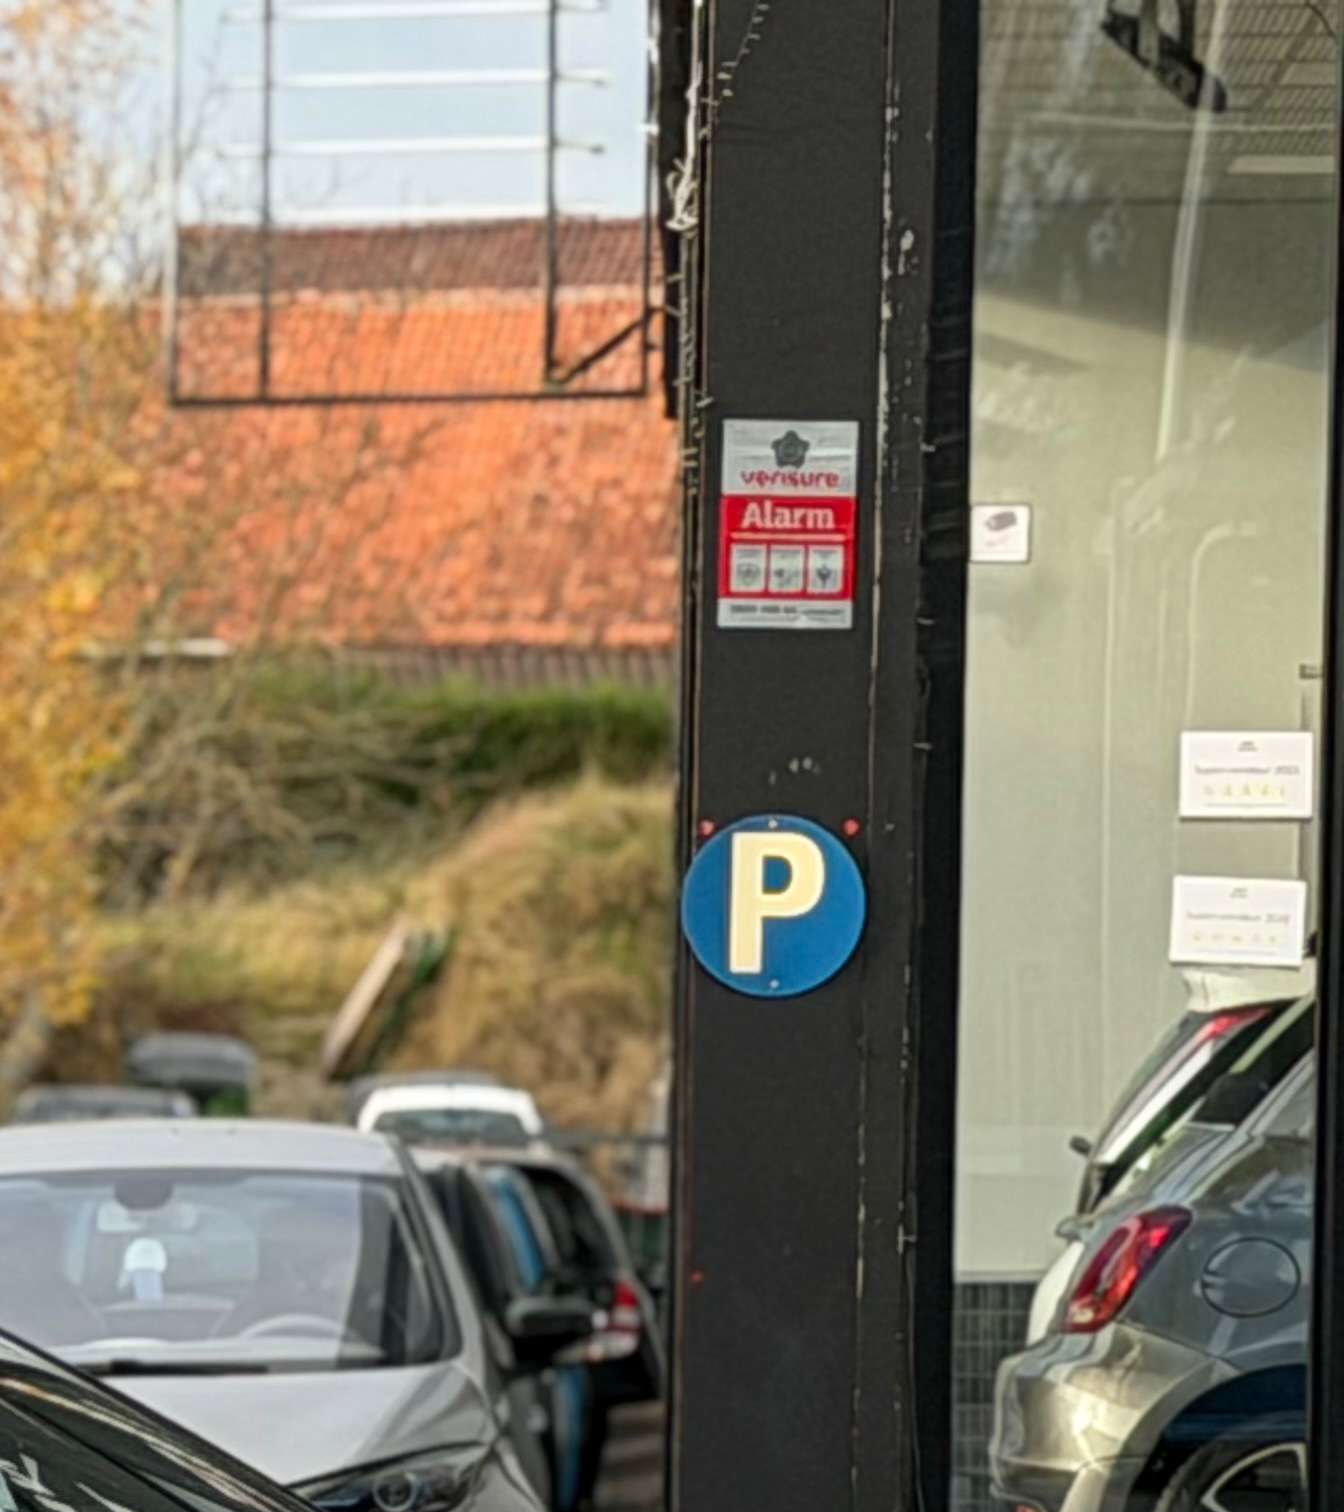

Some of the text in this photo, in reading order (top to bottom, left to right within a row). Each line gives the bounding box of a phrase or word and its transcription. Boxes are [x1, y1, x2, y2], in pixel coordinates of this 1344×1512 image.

[740, 470, 840, 487] verisure
[741, 500, 836, 530] Alarm
[729, 831, 825, 974] P
